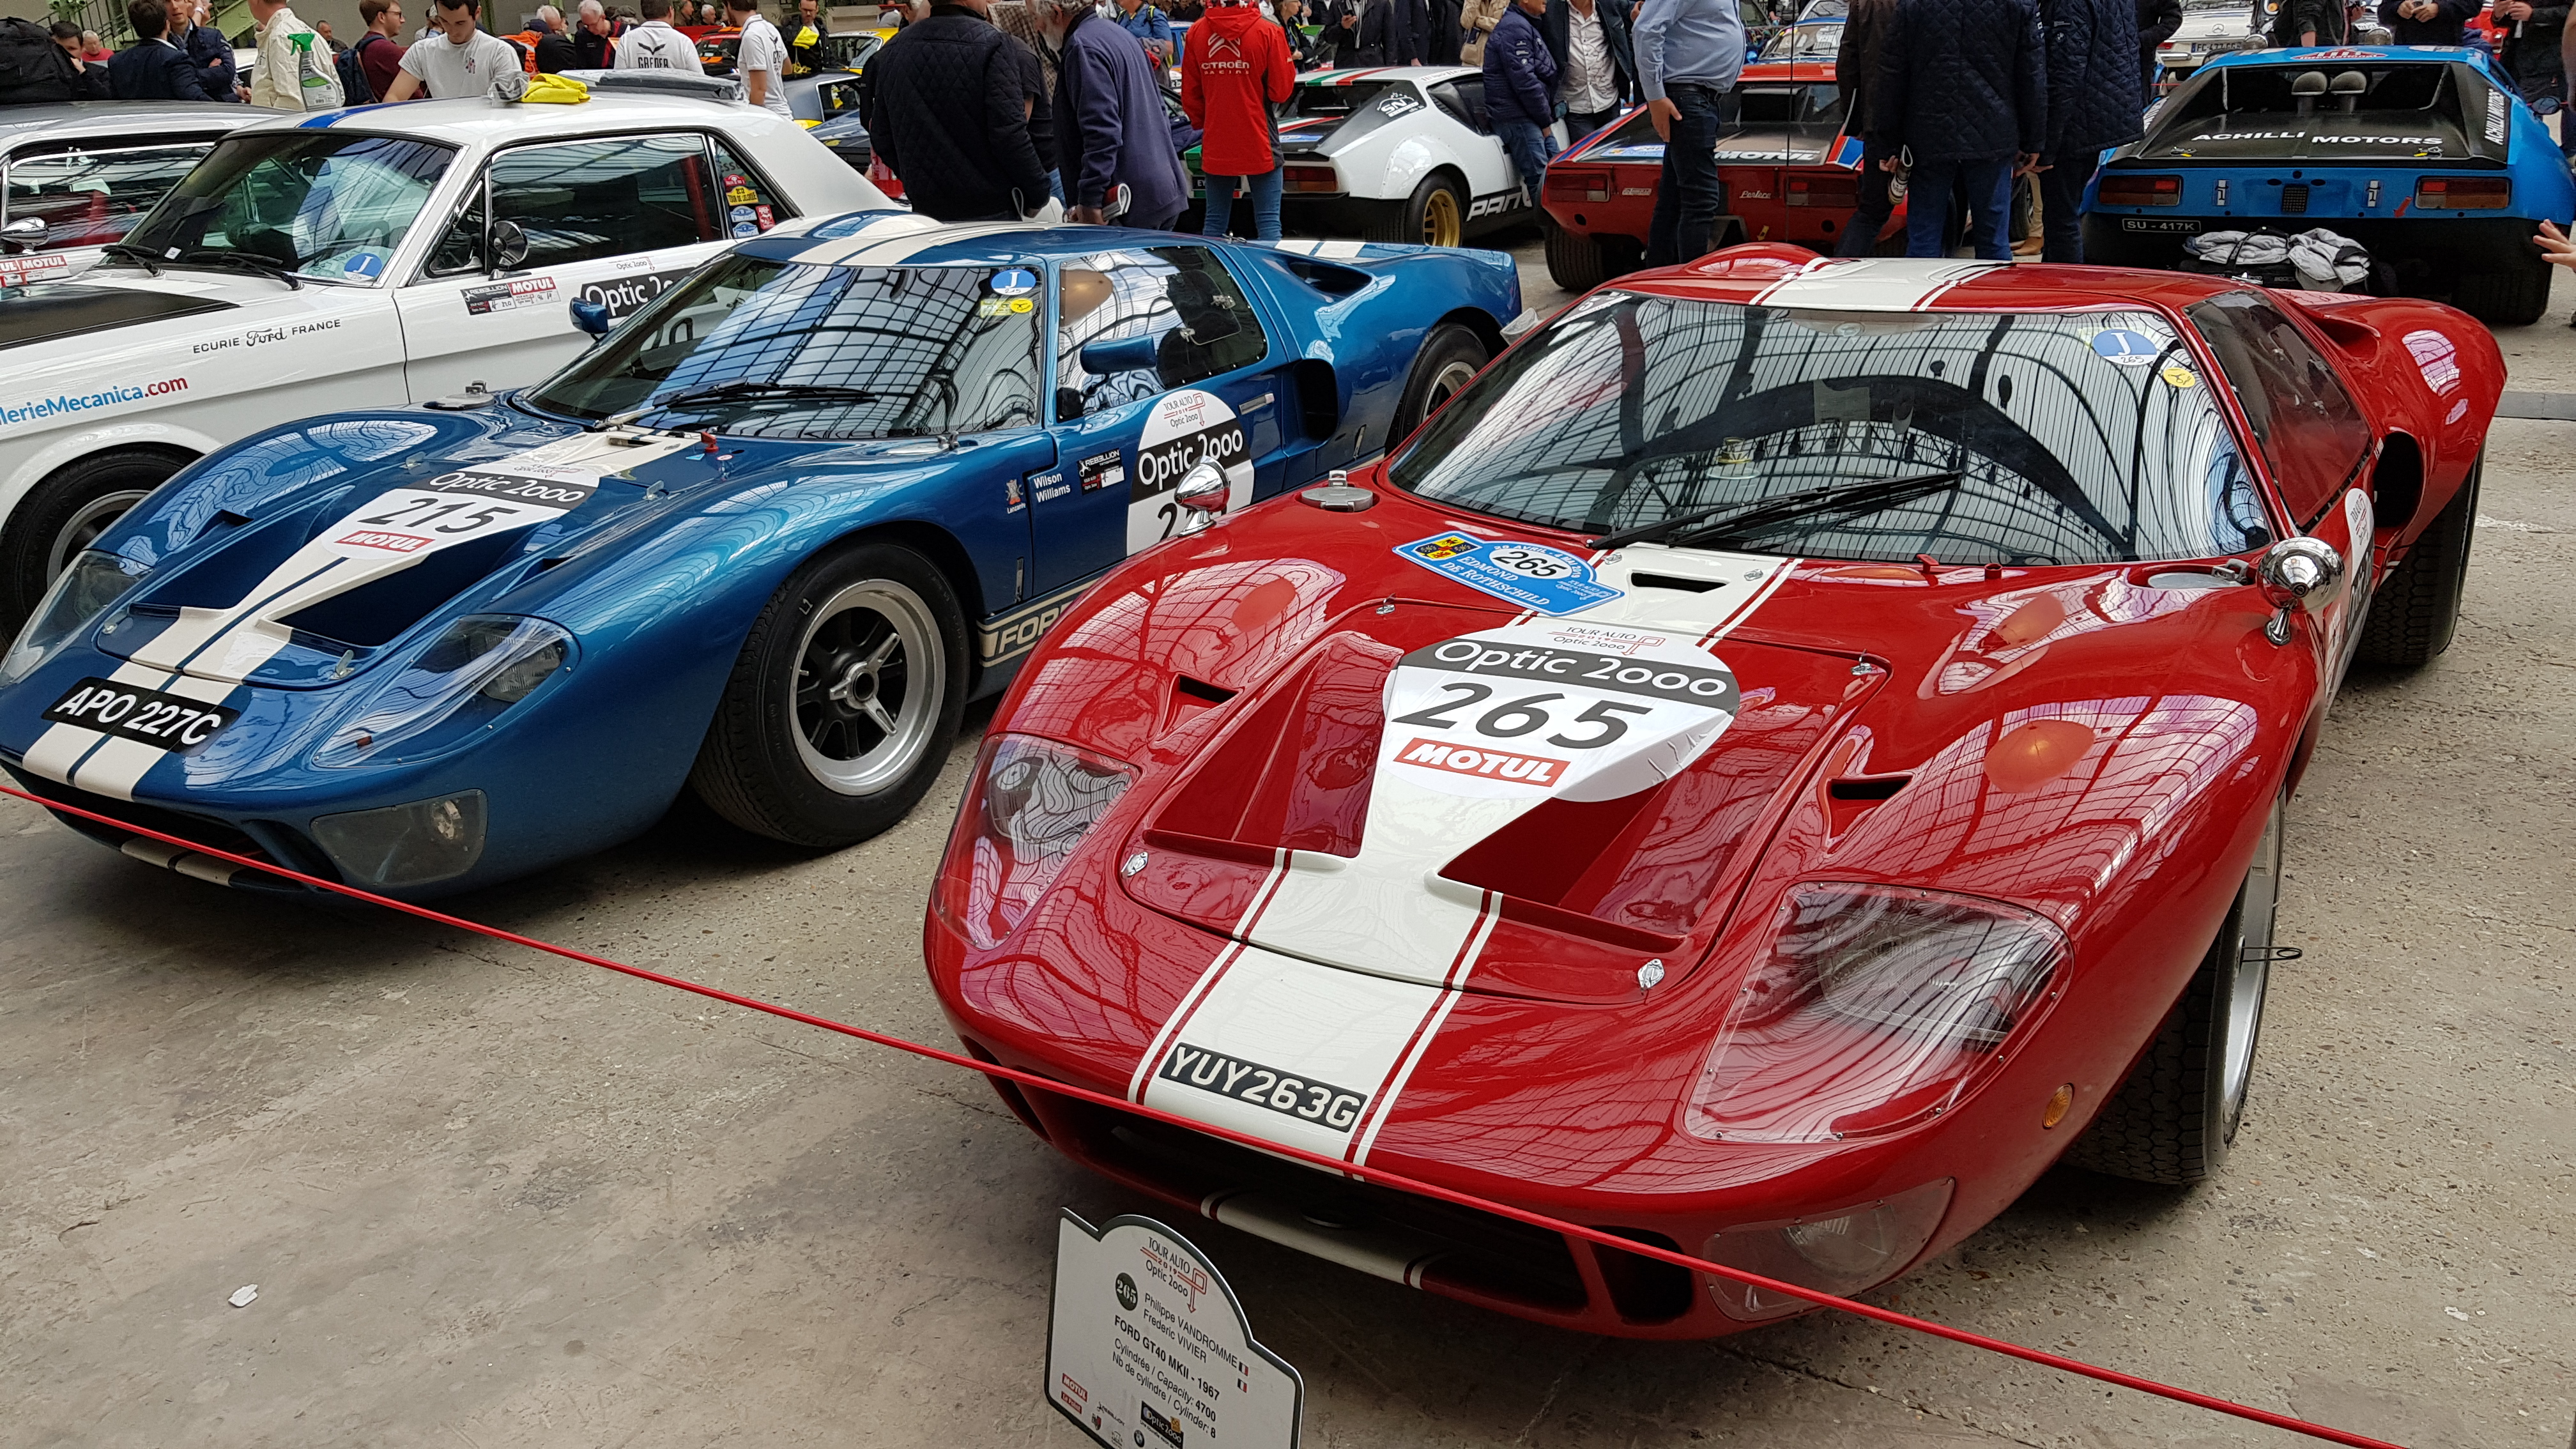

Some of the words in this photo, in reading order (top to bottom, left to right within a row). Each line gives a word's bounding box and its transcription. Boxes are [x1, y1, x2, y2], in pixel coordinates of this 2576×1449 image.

[2191, 132, 2306, 141] ACHILLI
[2312, 136, 2443, 145] MOTORS
[1713, 151, 1815, 160] MOTUL
[1466, 192, 1522, 222] PAN
[2127, 221, 2147, 229] SU
[2159, 222, 2196, 231] 417K
[0, 262, 17, 272] UL
[22, 256, 65, 269] MOTUL
[353, 255, 374, 273] J
[512, 277, 554, 294] MOTUL
[1005, 272, 1020, 288] J
[585, 279, 649, 317] Optic
[193, 337, 240, 354] ECURIE
[246, 327, 288, 347] Ford
[291, 319, 341, 335] FRANCE
[2110, 332, 2131, 356] J
[2120, 355, 2145, 364] 265
[0, 377, 188, 425] lerieMecanica.com
[1163, 400, 1179, 411] TOUR
[1170, 416, 1185, 429] Optic
[1185, 413, 1199, 424] 2000
[1085, 450, 1120, 467] REBELLION
[1138, 441, 1193, 491] Optic
[1197, 429, 1243, 460] 2000
[429, 472, 511, 491] Optic
[502, 480, 585, 502] 2000
[1034, 473, 1062, 489] Wilson
[1036, 485, 1071, 503] Williams
[357, 498, 521, 533] 215
[345, 533, 422, 551] MOTUL
[1457, 556, 1519, 581] EDMOND
[1492, 551, 1568, 577] 265
[1512, 545, 1549, 555] AVRIL
[1562, 555, 1578, 567] MAI
[1571, 565, 1583, 579] 2019
[1439, 562, 1464, 574] DE
[1464, 567, 1551, 605] ROTHSCHILD
[999, 604, 1070, 654] FOR
[1554, 636, 1590, 646] Optic
[1591, 641, 1625, 650] 2000
[1566, 627, 1600, 636] TOUR
[1601, 631, 1636, 640] AUTO
[1434, 641, 1577, 673] Optic
[1581, 657, 1728, 696] 2000
[54, 686, 137, 723] APO
[123, 701, 221, 745] 227C
[1390, 682, 1653, 749] 265
[1411, 744, 1555, 783] MOTUL
[1170, 1046, 1361, 1127] YUY263G
[1148, 1236, 1169, 1260] TOUR
[1169, 1254, 1191, 1275] AUTO
[1157, 1257, 1178, 1275] 2019
[1146, 1259, 1167, 1283] Optic
[1168, 1274, 1188, 1297] 2000
[1116, 1280, 1138, 1305] 265
[1143, 1309, 1176, 1340] Frederic
[1177, 1335, 1207, 1363] VIVIER
[1144, 1292, 1176, 1323] Philippe
[1177, 1316, 1238, 1368] VANDROMME
[1114, 1314, 1140, 1342] FORD
[1142, 1337, 1167, 1362] GT40
[1168, 1354, 1189, 1380] MKII
[1197, 1377, 1220, 1401] 1967
[1063, 1376, 1087, 1401] MOTUL
[1114, 1338, 1150, 1372] Cylindrée
[1157, 1370, 1194, 1406] Capacity:
[1195, 1399, 1216, 1422] 4700
[1112, 1351, 1123, 1368] Nb
[1125, 1362, 1135, 1376] de
[1136, 1372, 1167, 1400] cylindre
[1173, 1399, 1209, 1434] Cylinder:
[1210, 1427, 1216, 1439] 8
